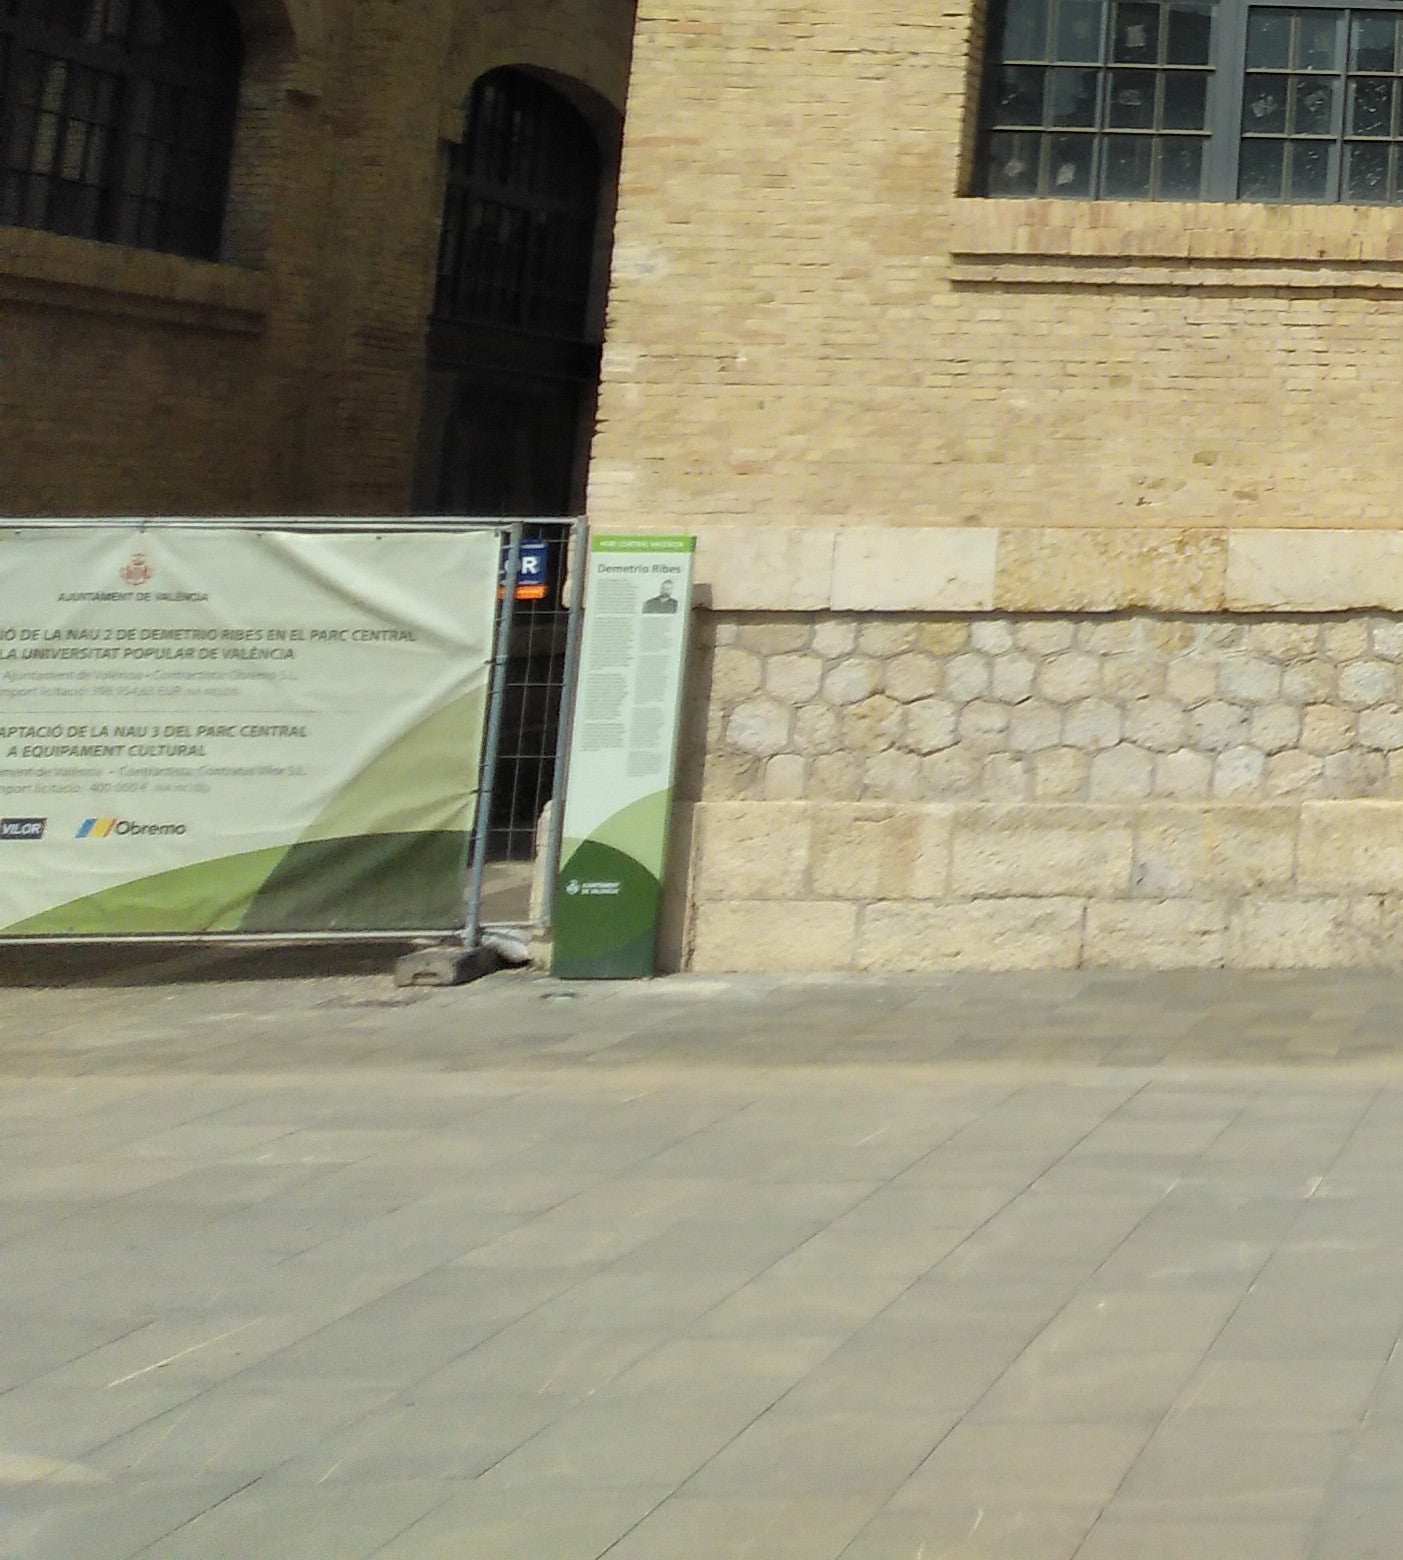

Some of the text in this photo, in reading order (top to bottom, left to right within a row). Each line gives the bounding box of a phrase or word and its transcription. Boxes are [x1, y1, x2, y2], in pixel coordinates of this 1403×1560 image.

[598, 563, 681, 574] Demetrio Ribes
[57, 591, 133, 602] AJUNTAMENT
[136, 591, 151, 602] DE
[19, 628, 40, 641] DE
[44, 628, 61, 641] LA
[65, 628, 99, 641] NAU
[103, 628, 113, 641] 2
[116, 628, 136, 641] DE
[140, 628, 216, 641] DEMETRIO
[220, 628, 264, 641] RIBES
[266, 628, 286, 641] EN
[289, 628, 306, 642] EL
[309, 628, 349, 642] PARC
[351, 629, 416, 643] CENTRAL
[22, 647, 120, 660] UNIVERSITAT
[123, 647, 195, 660] POPULAR
[199, 647, 218, 660] DE
[66, 725, 87, 738] DE
[91, 725, 108, 738] LA
[114, 725, 147, 738] NAU
[151, 725, 160, 738] 3
[163, 725, 192, 738] DEL
[196, 725, 237, 738] PARC
[240, 725, 307, 738] CENTRAL
[6, 745, 207, 759] A EQUIPAMENT CULTURAL
[2, 820, 187, 836] VILOR Obremo
